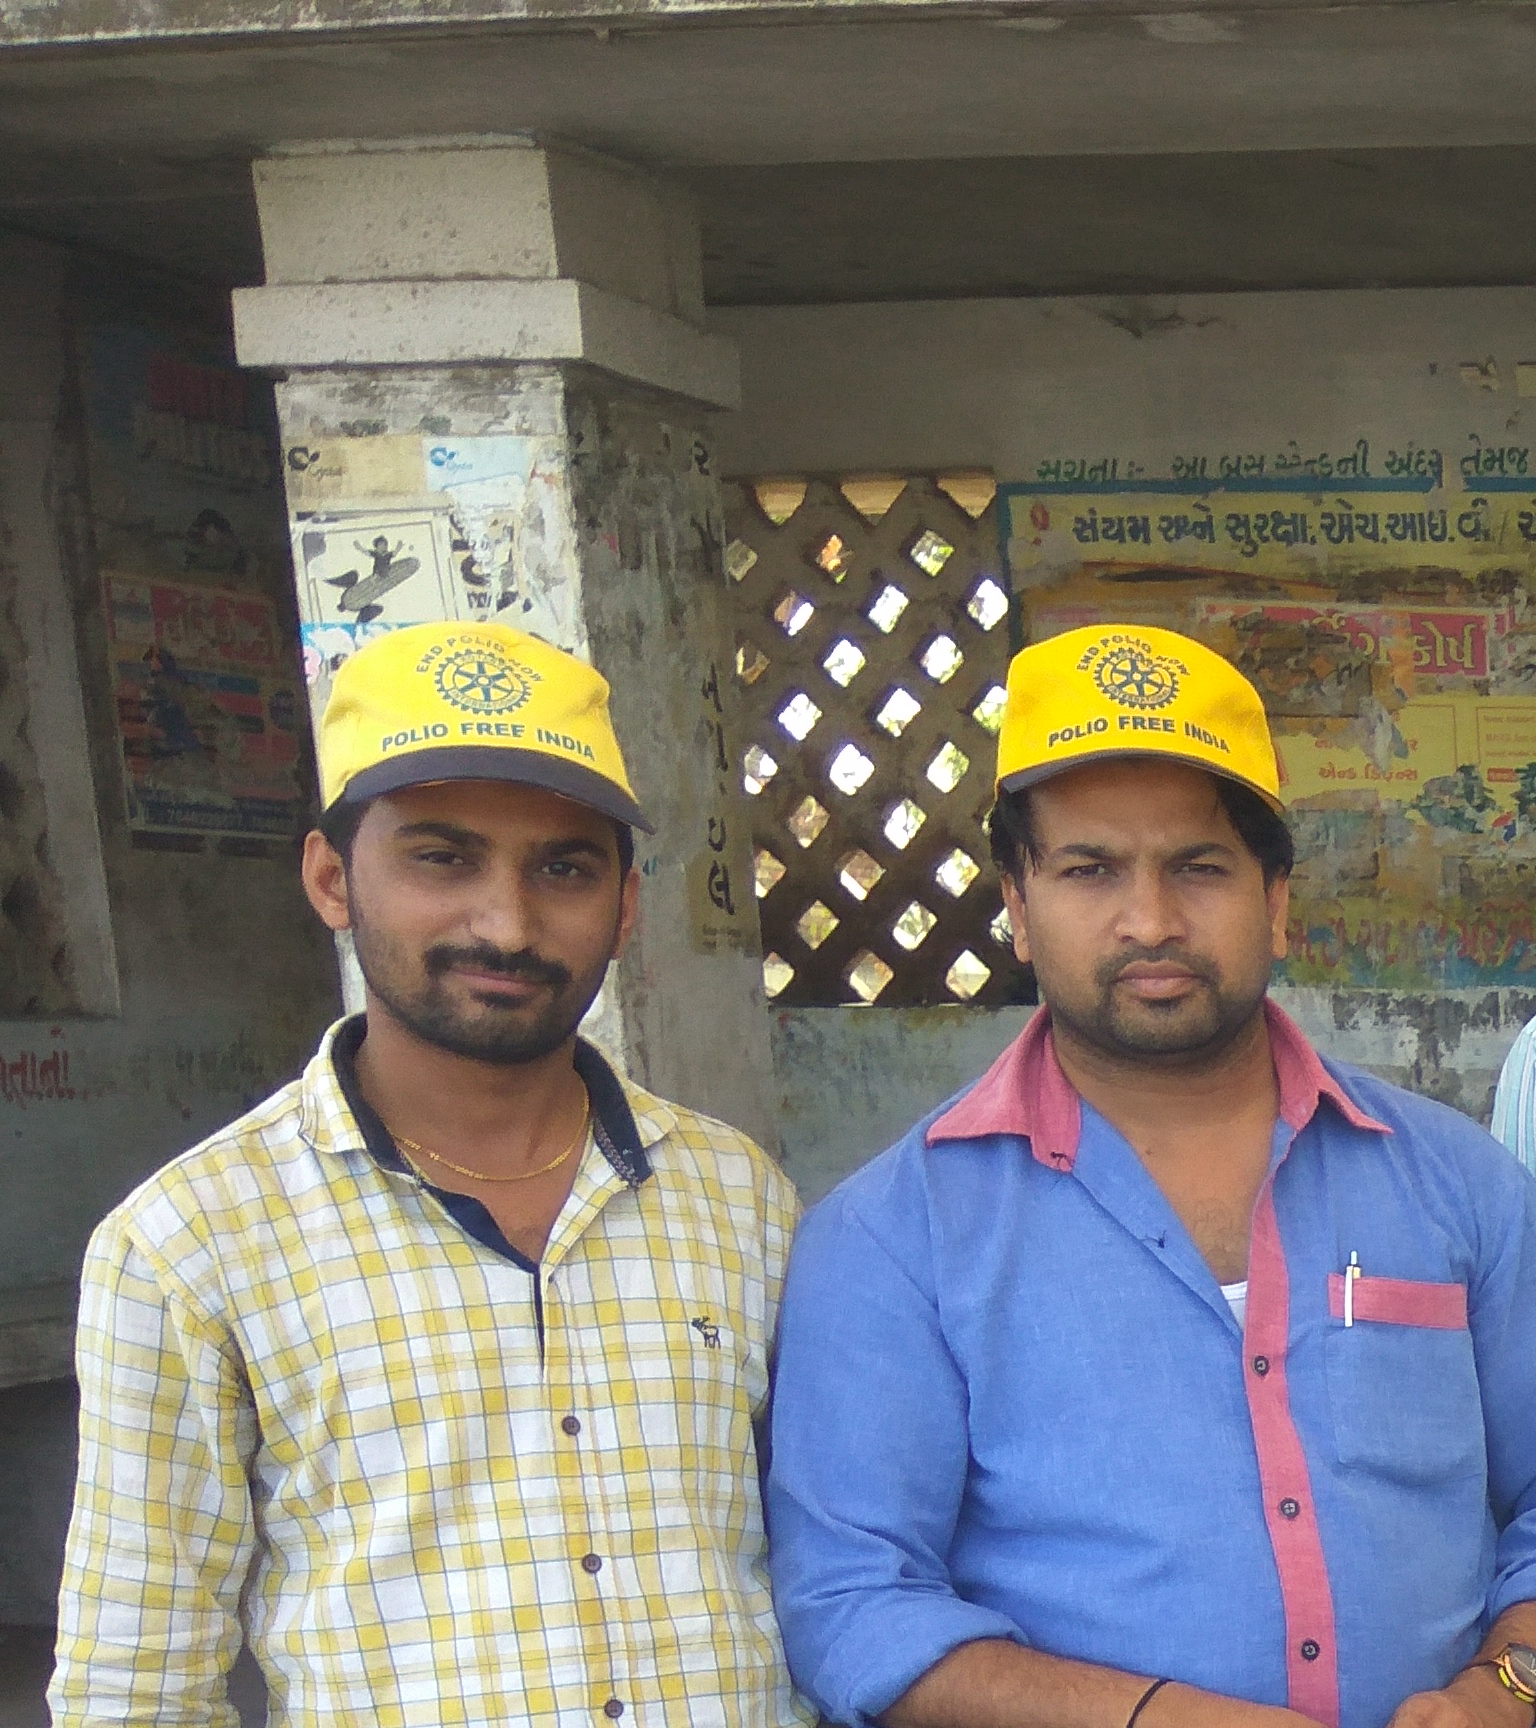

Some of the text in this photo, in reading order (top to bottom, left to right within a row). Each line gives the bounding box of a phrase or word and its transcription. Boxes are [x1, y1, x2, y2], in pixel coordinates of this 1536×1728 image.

[416, 644, 443, 674] END
[446, 634, 506, 654] POLIO
[1076, 646, 1100, 672] END
[1100, 634, 1152, 654] POLIO
[381, 721, 596, 761] POLIO FREE INDIA
[1048, 714, 1231, 754] POLIO FREE INDIA
